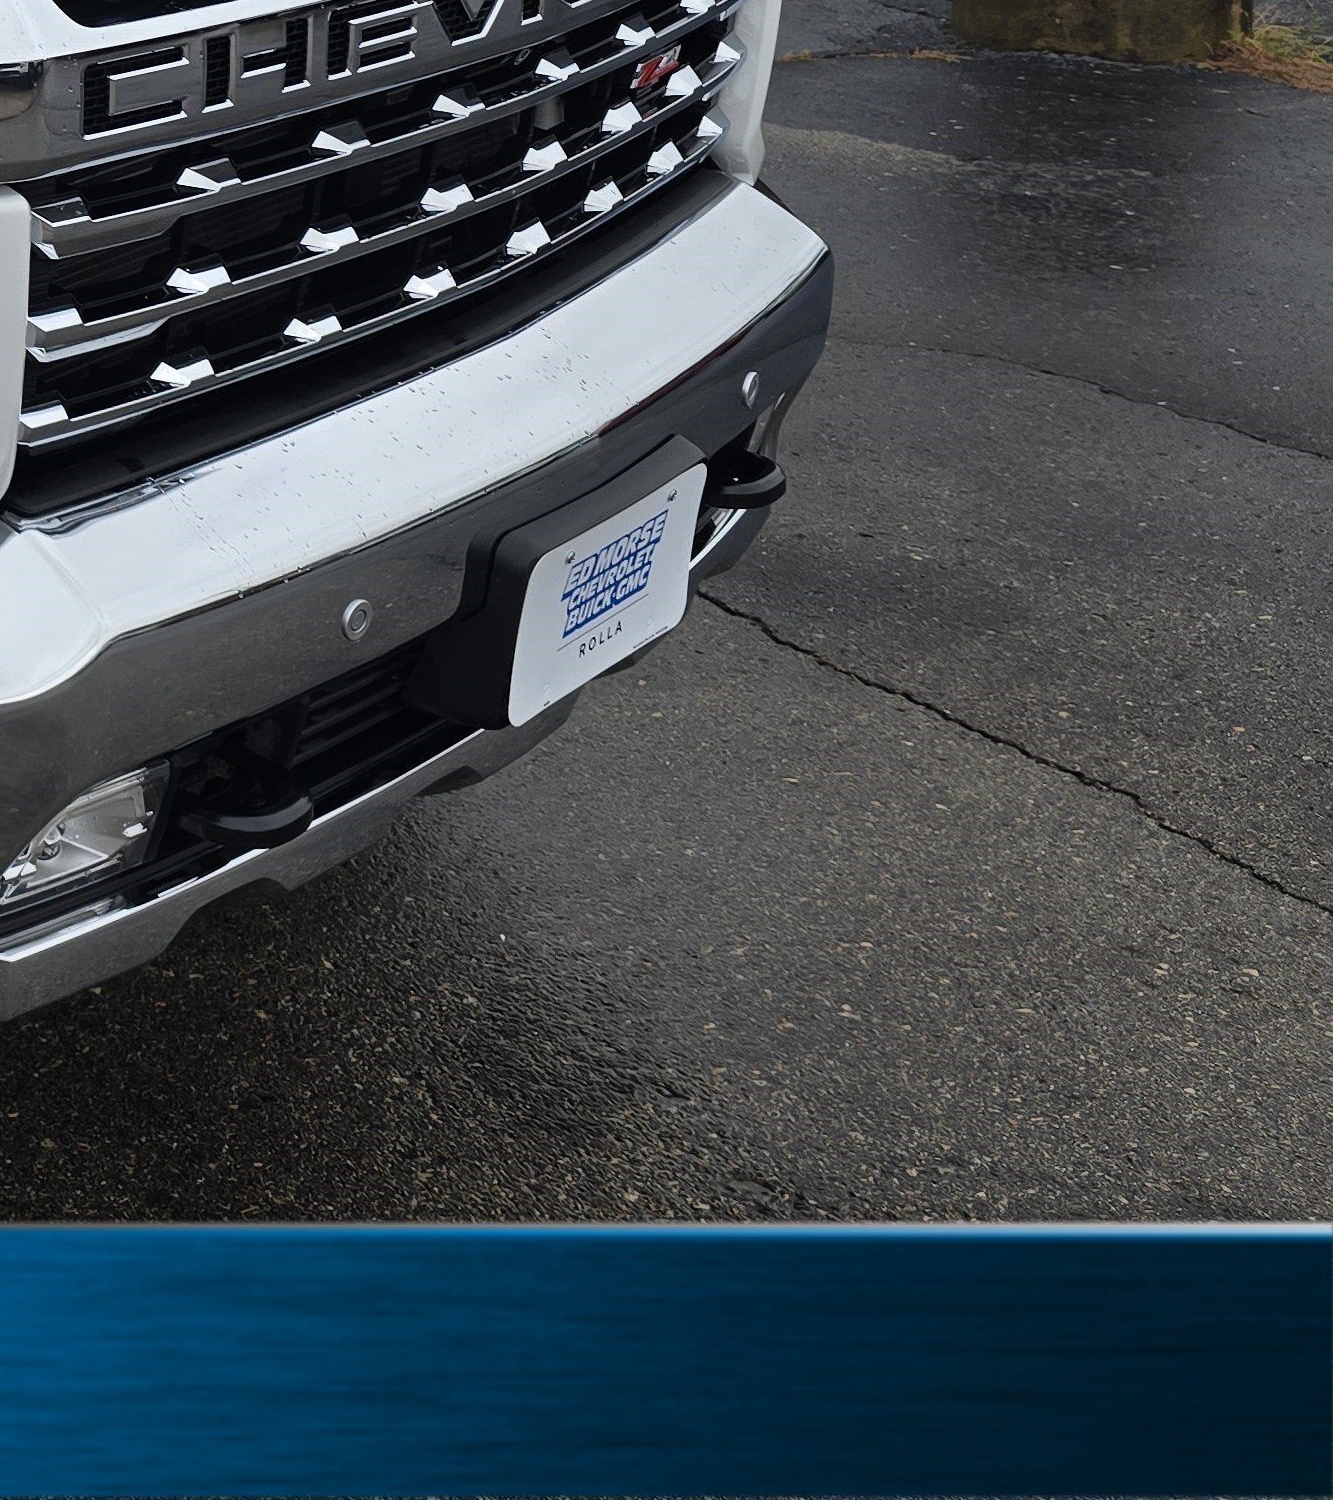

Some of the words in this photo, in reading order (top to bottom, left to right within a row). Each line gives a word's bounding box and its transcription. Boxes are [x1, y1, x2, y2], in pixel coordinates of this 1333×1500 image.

[563, 554, 599, 599] ED
[593, 510, 668, 576] MORSE
[567, 544, 655, 612] CHEVROLET
[577, 620, 623, 659] ROLLA
